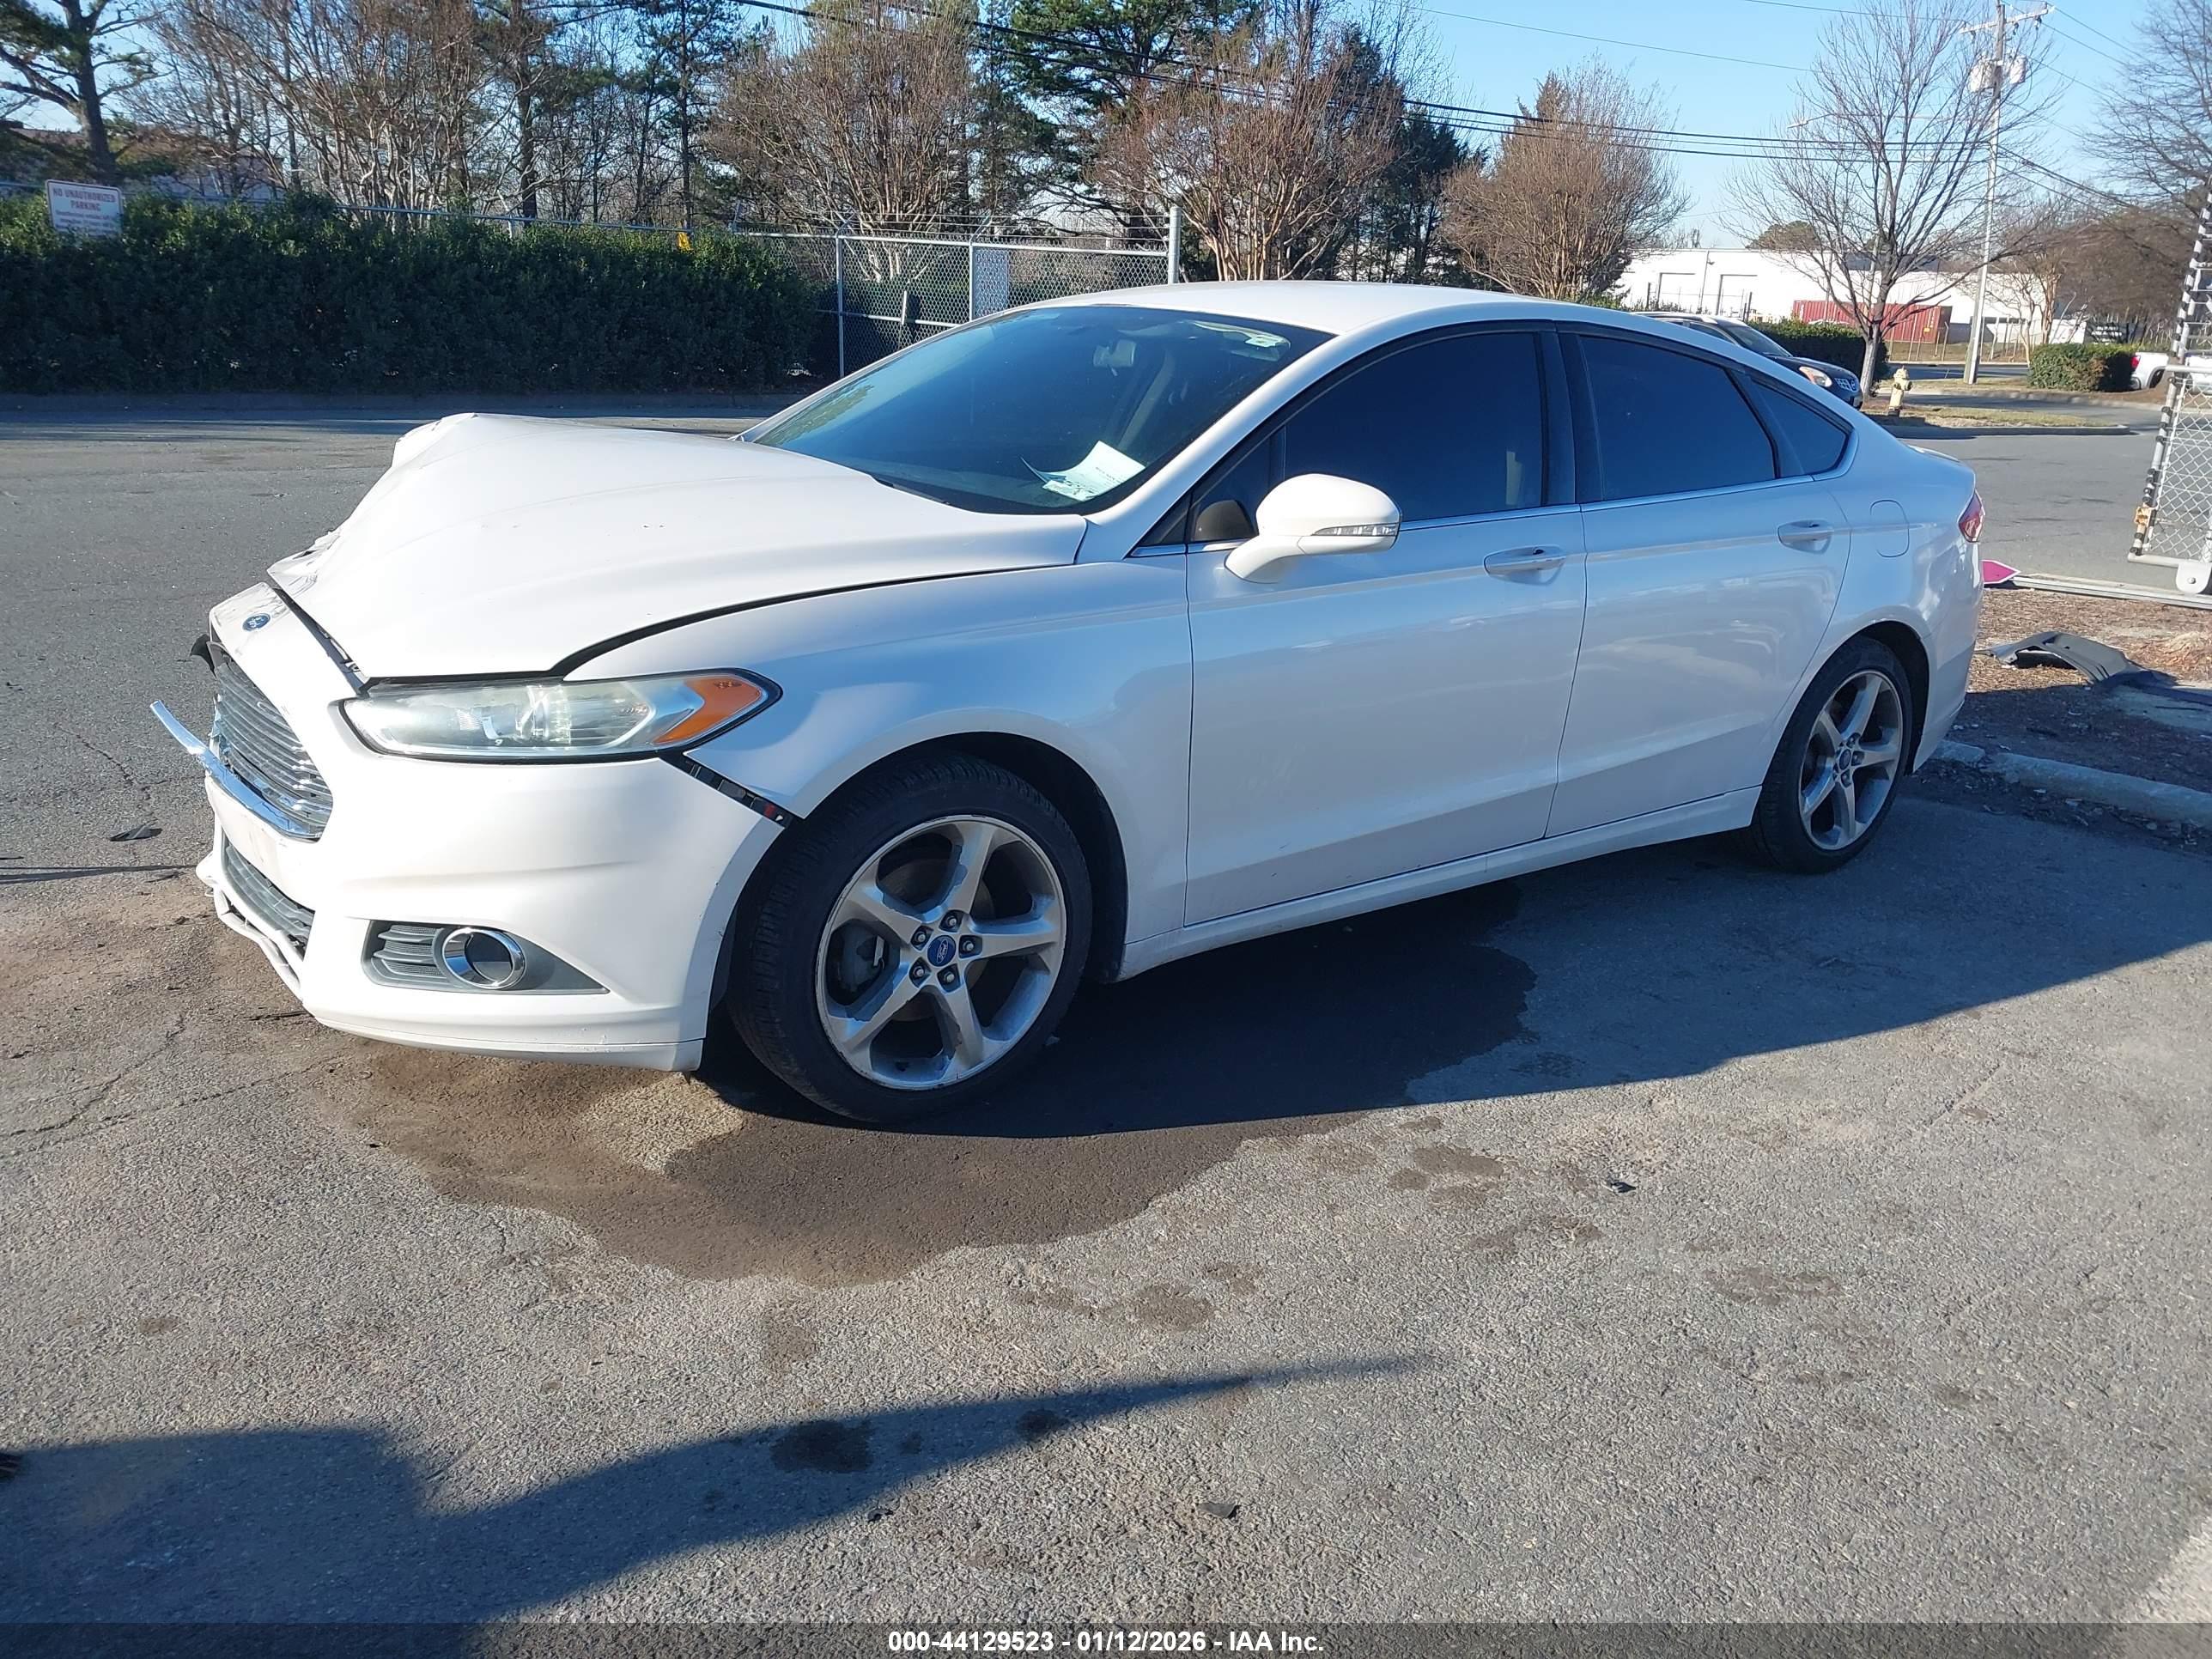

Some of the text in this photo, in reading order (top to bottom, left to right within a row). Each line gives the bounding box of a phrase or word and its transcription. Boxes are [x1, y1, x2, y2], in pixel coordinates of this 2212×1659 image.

[52, 187, 116, 203] NO UNAUTHORIZED
[70, 200, 101, 211] PARKING
